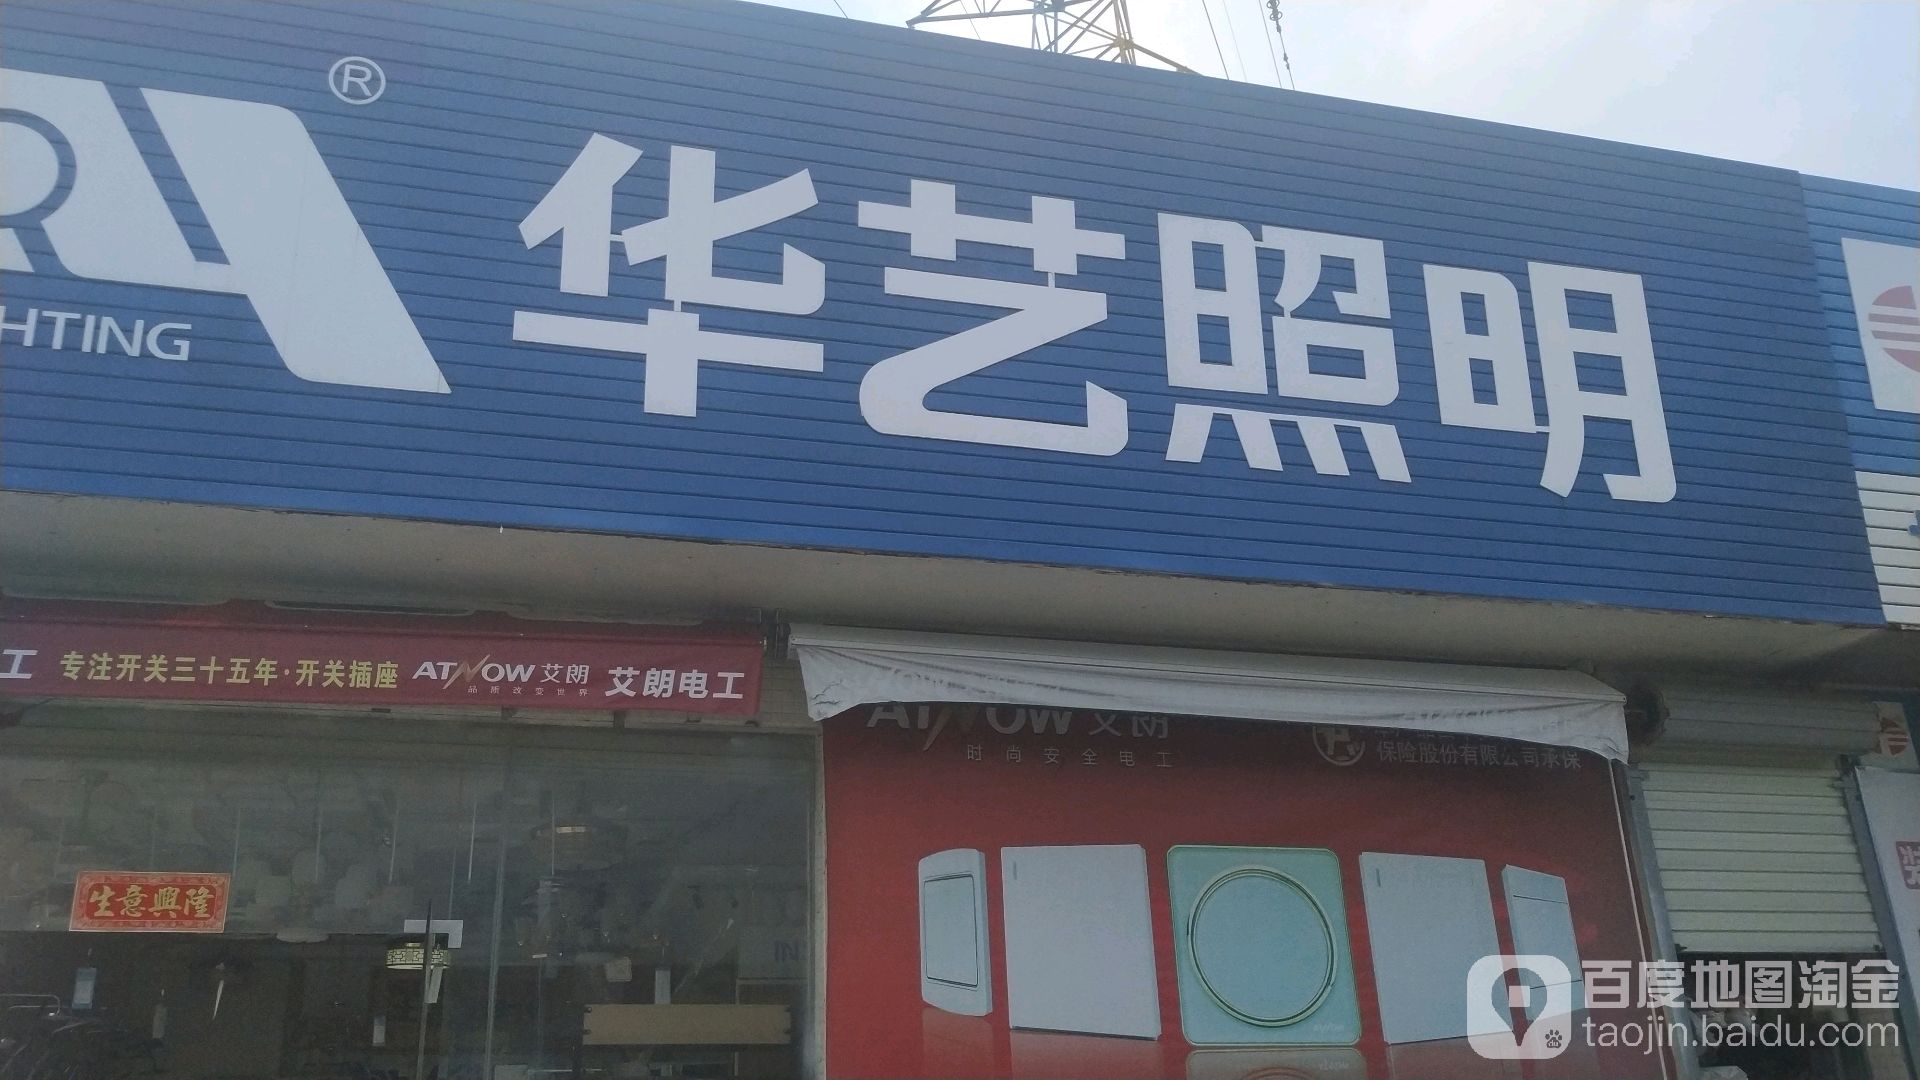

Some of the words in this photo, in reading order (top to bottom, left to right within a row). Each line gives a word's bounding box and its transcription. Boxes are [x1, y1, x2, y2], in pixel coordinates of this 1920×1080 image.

[512, 132, 1677, 503] 华艺照明
[539, 663, 590, 685] 艾朗
[605, 667, 745, 699] 艾朗电工
[967, 744, 1173, 768] 时尚安全电工
[1377, 740, 1582, 769] 保险股份有限公司承保
